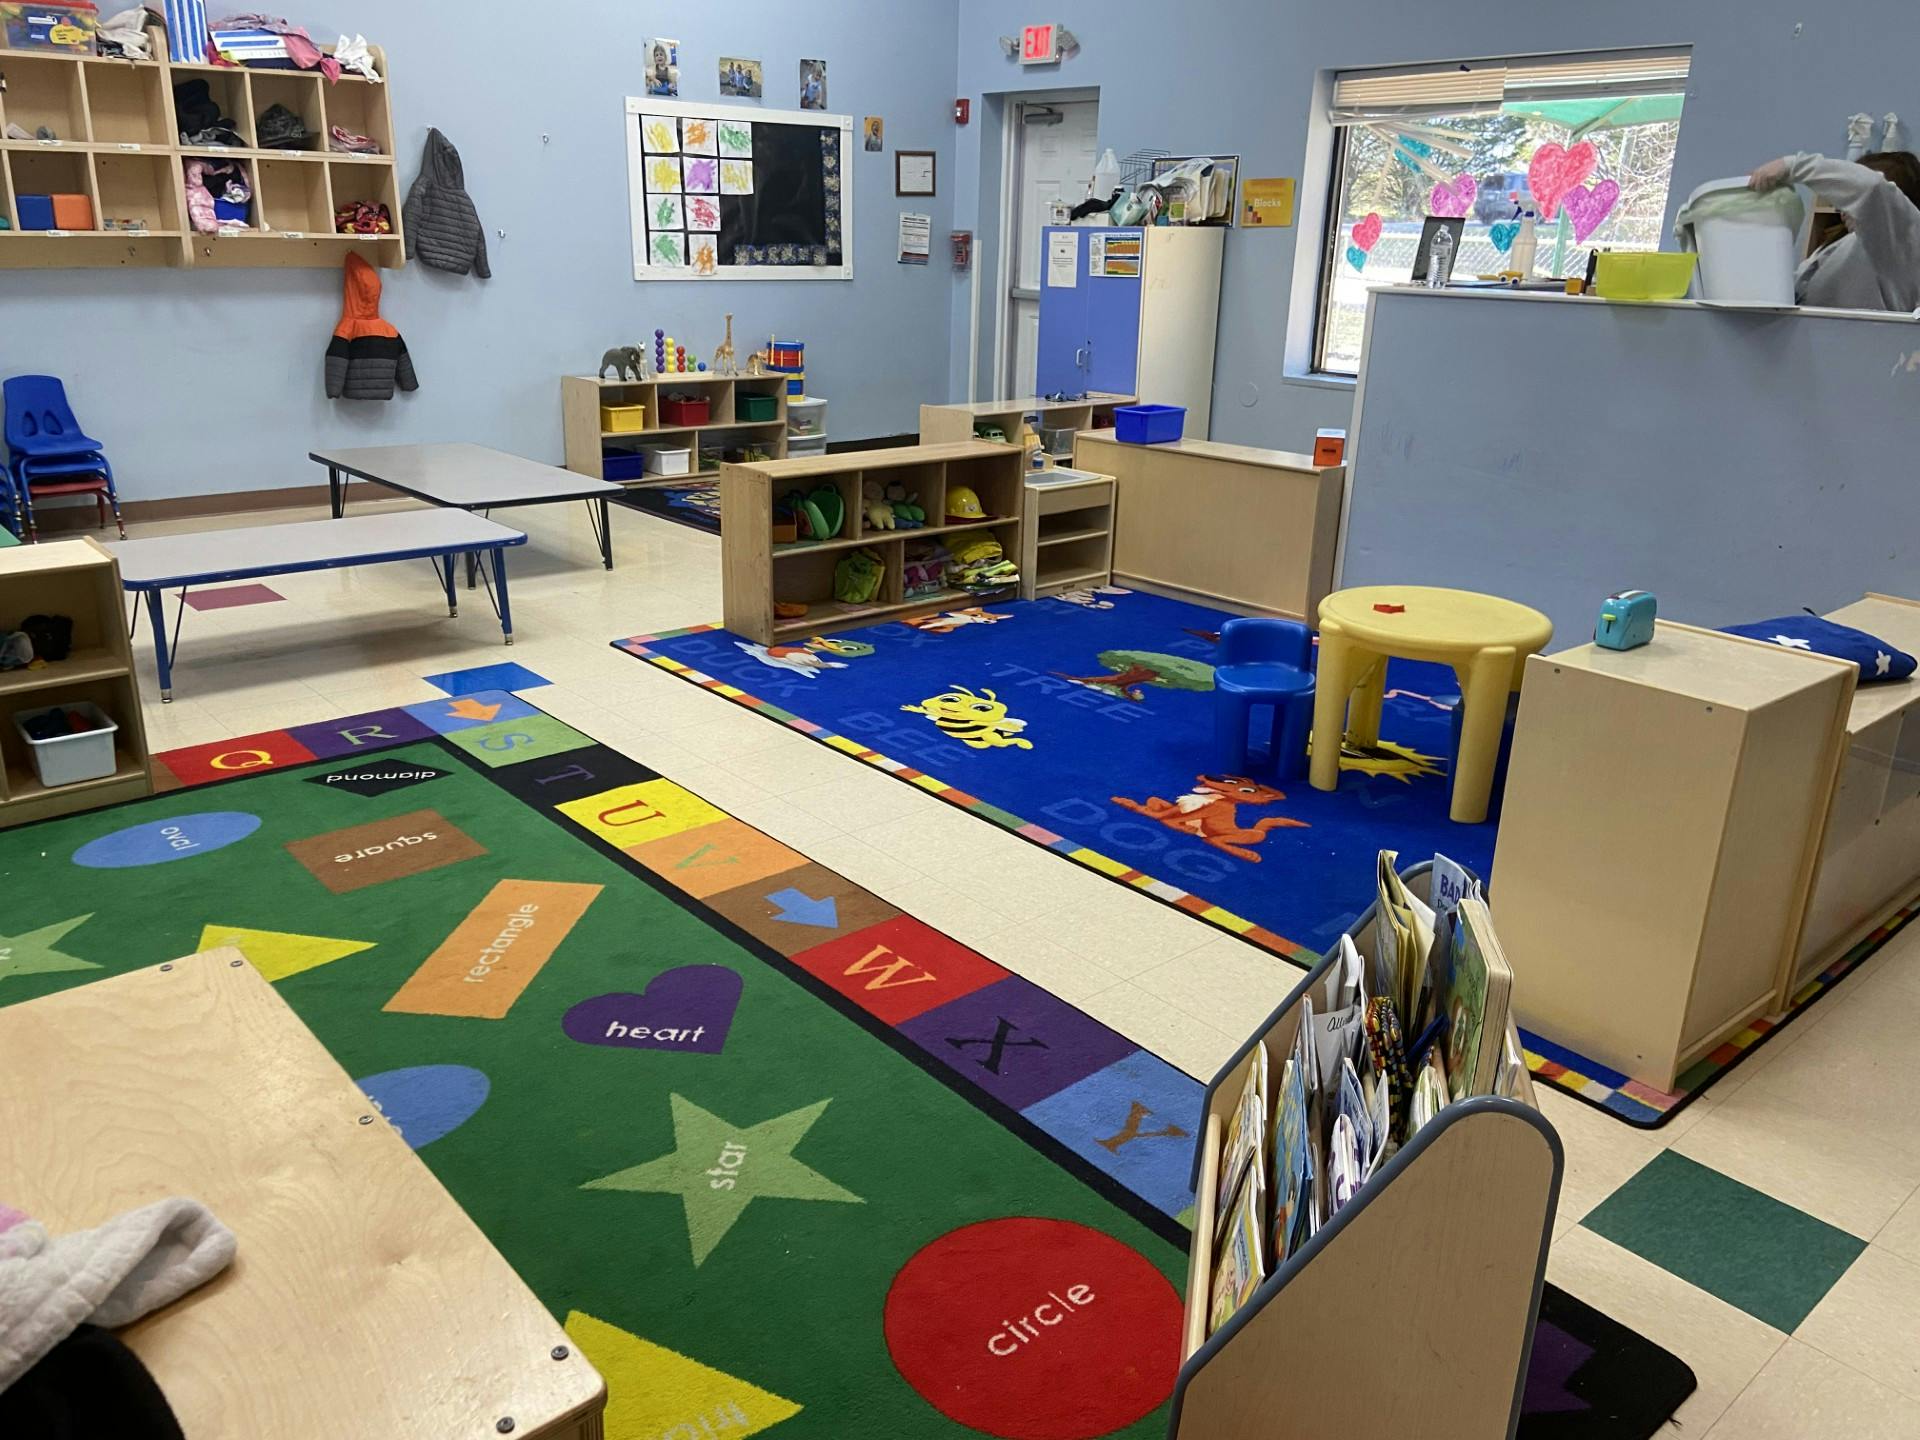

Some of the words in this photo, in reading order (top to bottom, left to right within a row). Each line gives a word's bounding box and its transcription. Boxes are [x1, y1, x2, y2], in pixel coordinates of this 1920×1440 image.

[1024, 25, 1052, 59] EXIT
[866, 624, 943, 648] OX
[669, 639, 818, 698] DUCK
[991, 663, 1156, 724] TREE
[337, 725, 398, 746] R
[473, 732, 535, 752] S
[837, 711, 977, 767] BEE
[210, 750, 274, 770] Q
[534, 764, 596, 786] T
[326, 771, 437, 784] diamond
[597, 799, 667, 827] U
[160, 825, 201, 851] oval
[334, 831, 439, 864] square
[1039, 797, 1239, 883] DOG
[673, 842, 742, 870] V
[463, 903, 540, 983] rectangle
[843, 944, 937, 991] W
[605, 1021, 706, 1043] heart
[944, 1015, 1050, 1076] X
[1094, 1101, 1190, 1156] Y
[705, 1141, 748, 1191] star
[987, 1282, 1096, 1357] circle
